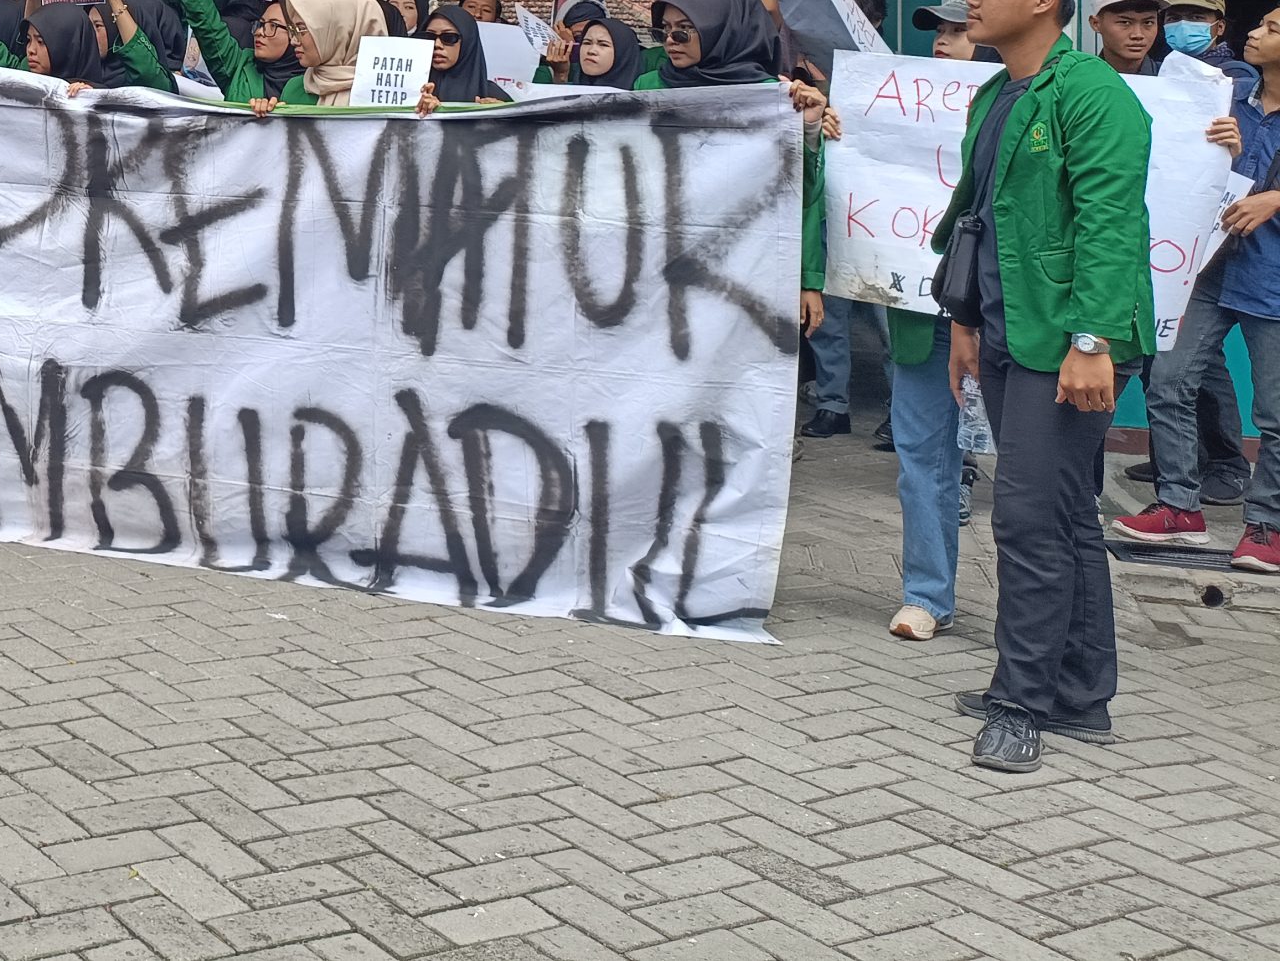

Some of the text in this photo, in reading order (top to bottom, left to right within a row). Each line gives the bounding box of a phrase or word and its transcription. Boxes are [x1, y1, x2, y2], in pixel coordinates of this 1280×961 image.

[373, 56, 413, 72] PATAH
[376, 73, 405, 88] HATI
[371, 89, 407, 105] TETAP
